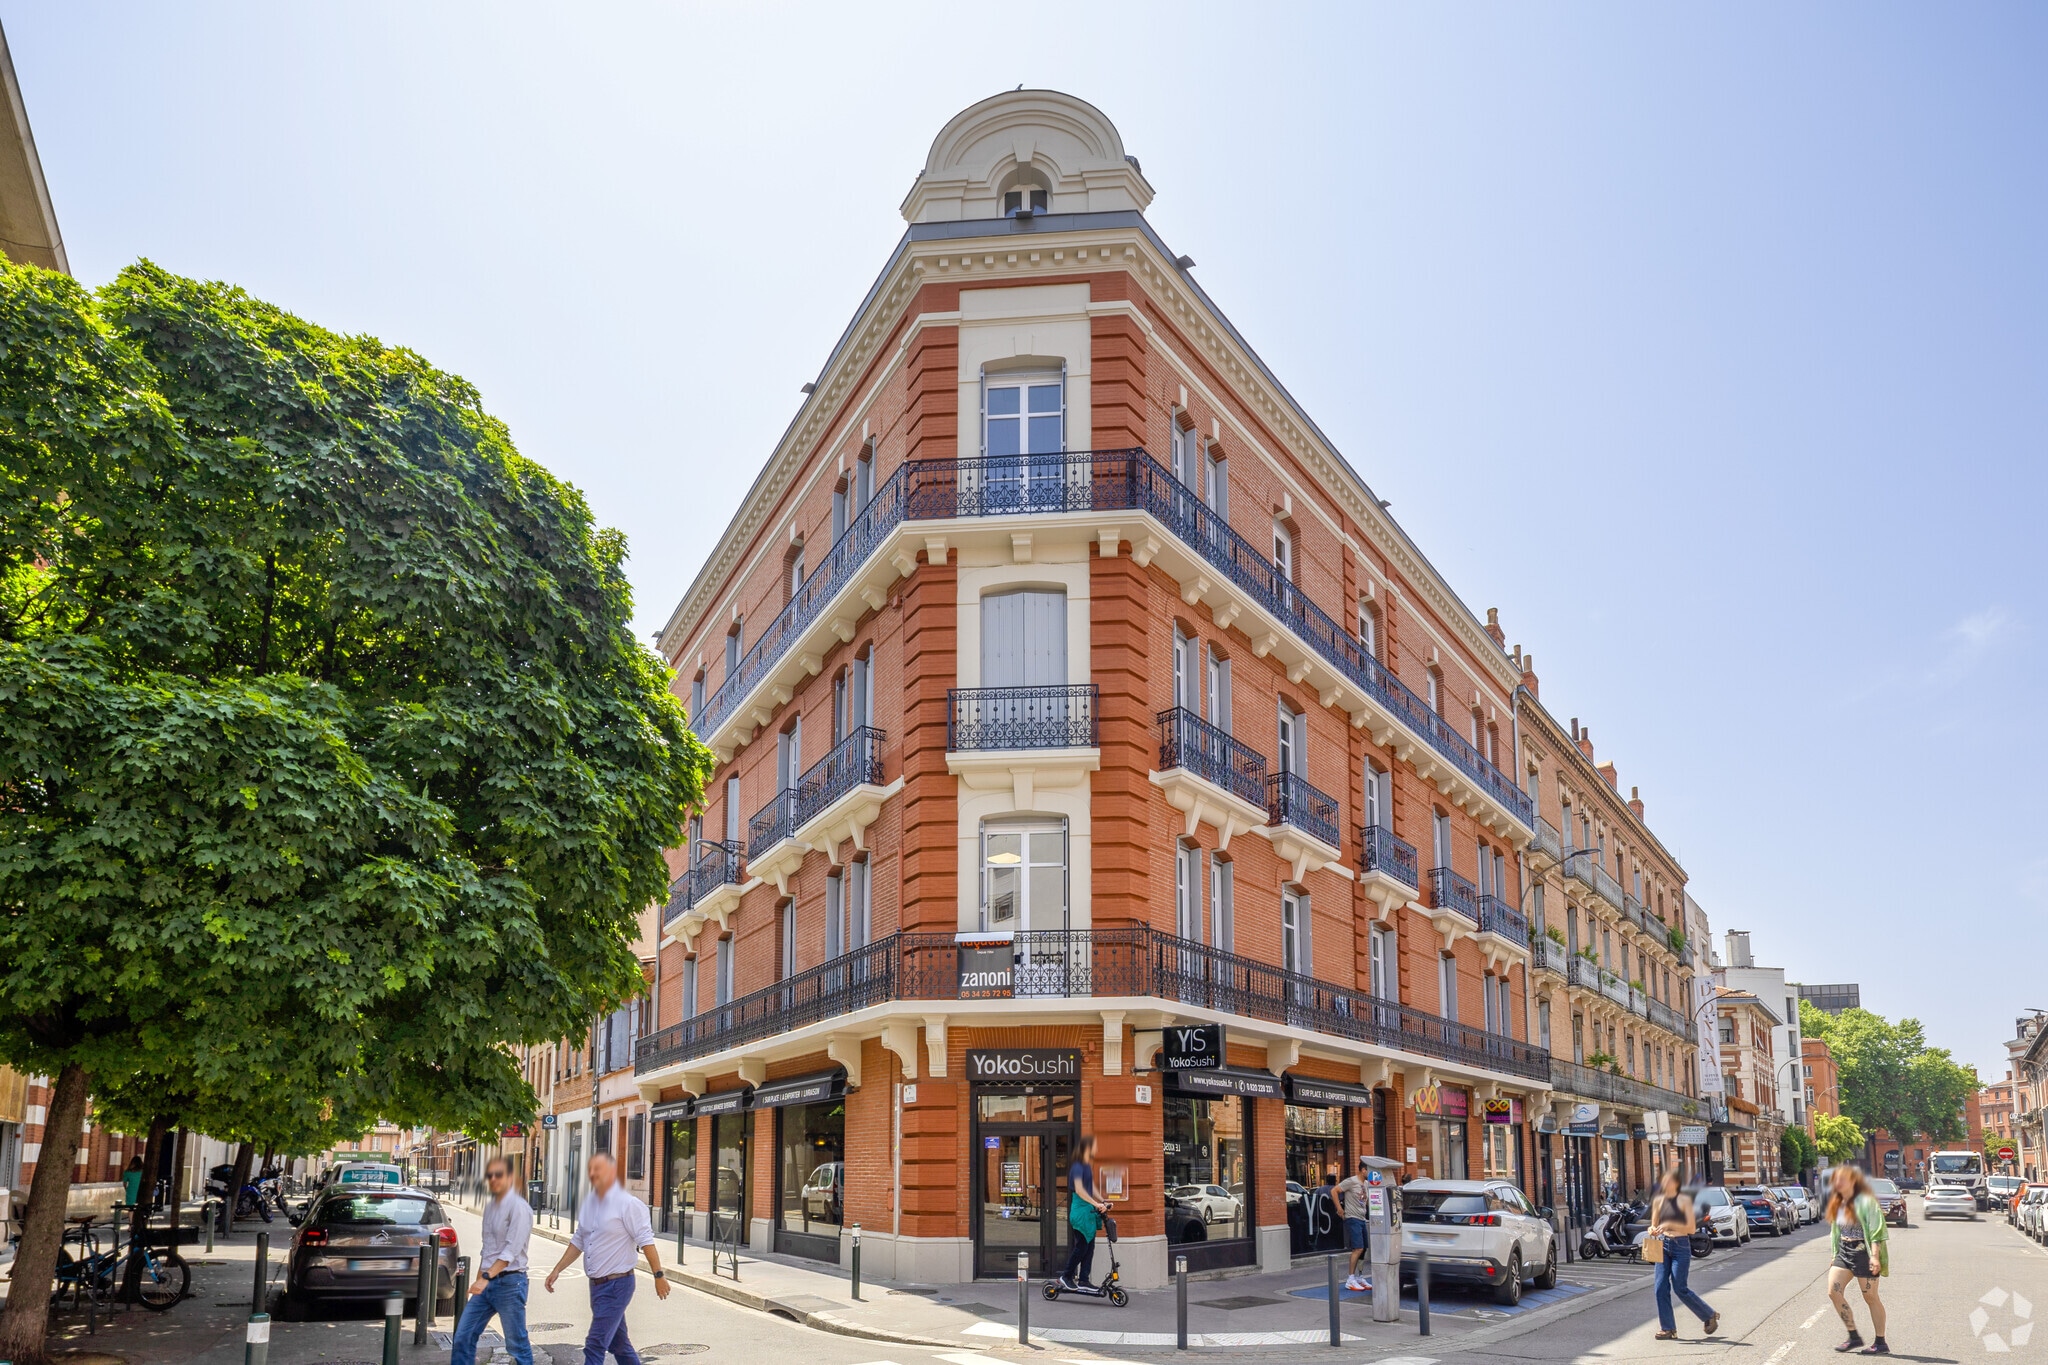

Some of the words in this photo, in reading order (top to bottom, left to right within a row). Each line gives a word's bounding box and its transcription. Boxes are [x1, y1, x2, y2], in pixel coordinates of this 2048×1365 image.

[961, 967, 1011, 987] zanoni
[973, 1054, 1074, 1075] YokoSushi
[1168, 1055, 1215, 1068] YokoSushi
[1193, 1077, 1233, 1088] www.yokosushi.fr
[1310, 1090, 1322, 1098] PLACE
